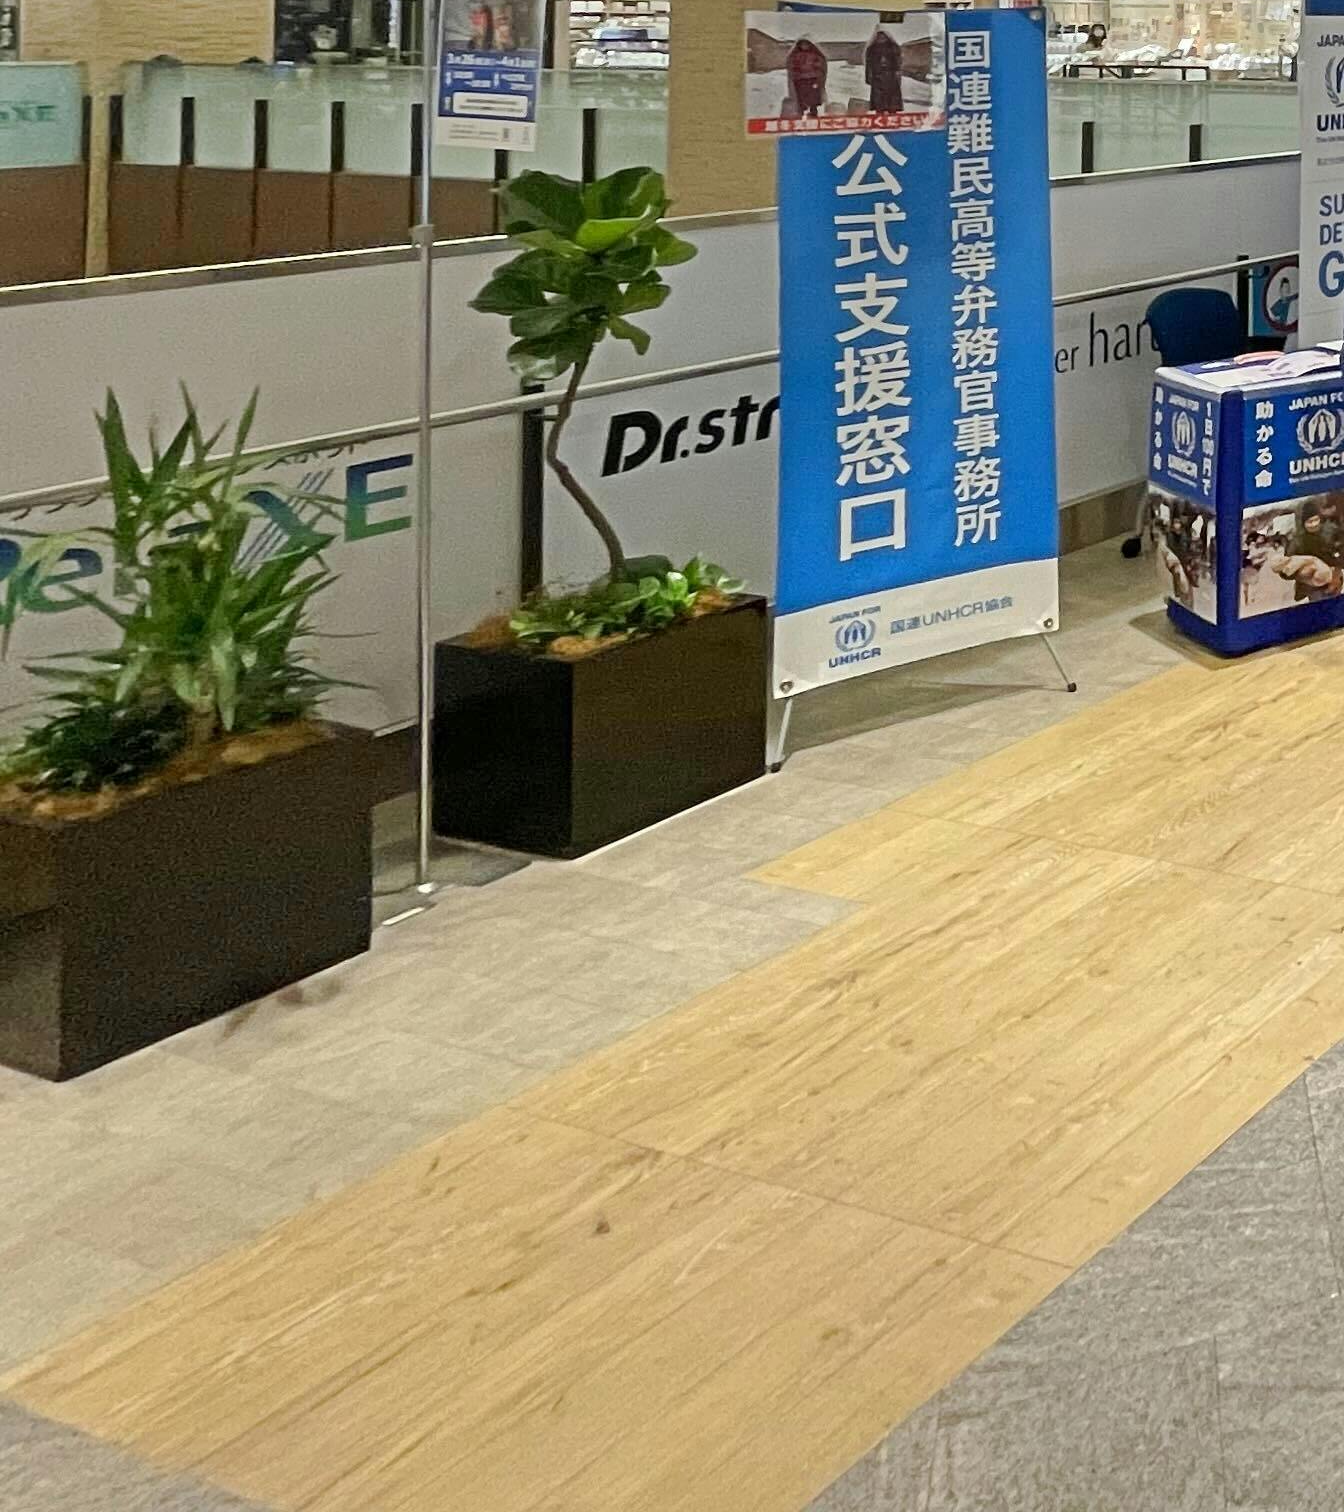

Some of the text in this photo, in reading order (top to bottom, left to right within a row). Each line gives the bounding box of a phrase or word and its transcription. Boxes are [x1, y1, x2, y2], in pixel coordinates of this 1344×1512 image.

[946, 30, 1002, 548] 国連難民高等弁務官事務所
[832, 133, 911, 563] 公式支援窓口
[1288, 396, 1328, 411] JAPAN
[1254, 400, 1275, 488] 助かる命
[889, 595, 1014, 635] 国連UNHCR協会
[828, 647, 882, 669] UNHCR
